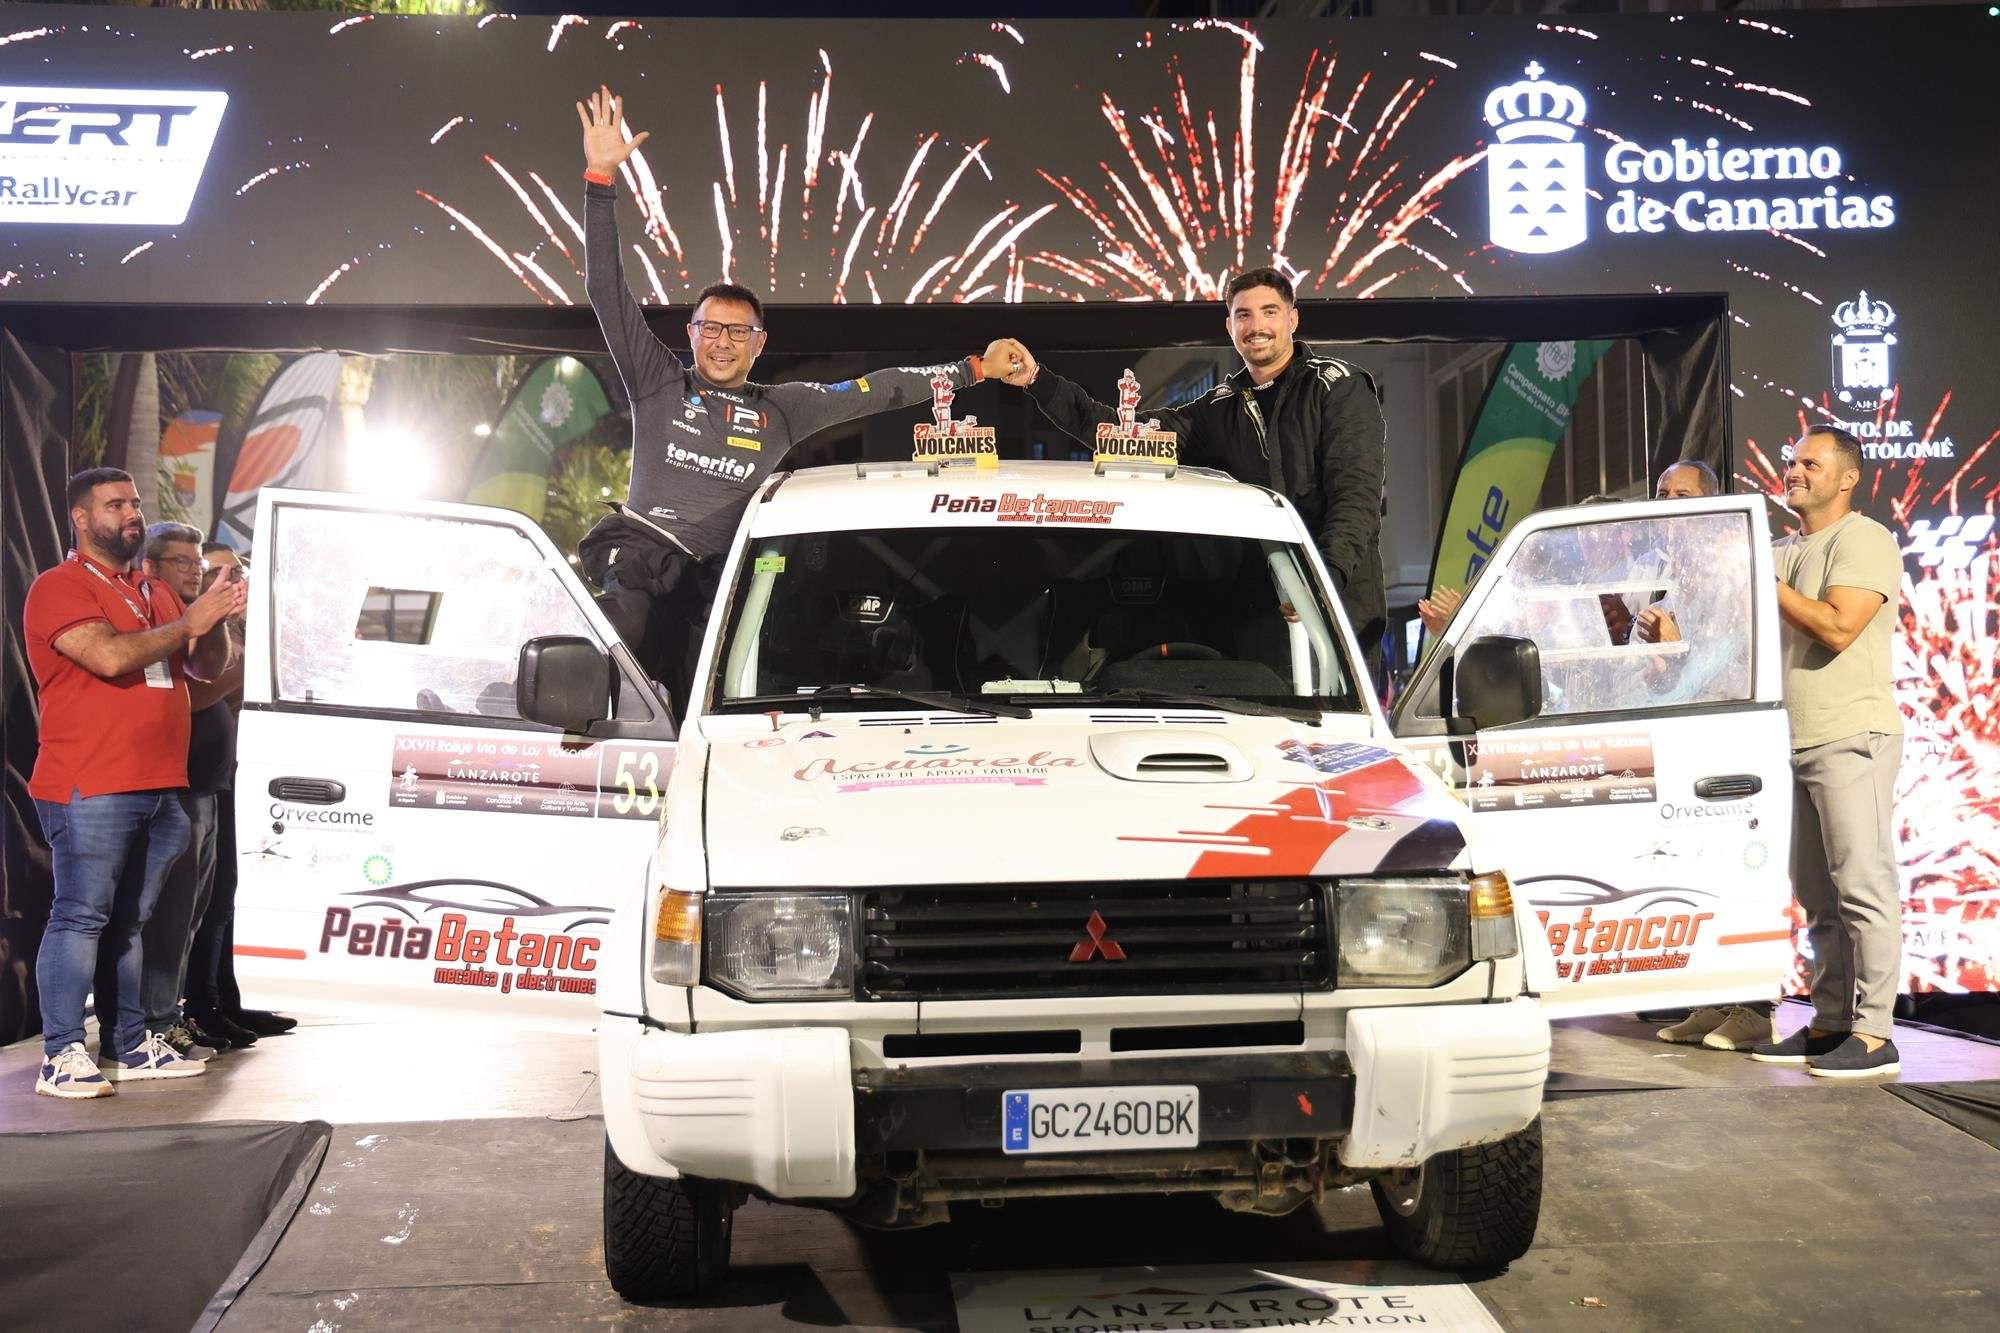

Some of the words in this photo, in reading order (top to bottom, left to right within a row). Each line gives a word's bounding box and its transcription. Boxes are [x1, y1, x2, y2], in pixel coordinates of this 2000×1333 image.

[1604, 138, 1842, 184] Gobierno
[0, 176, 138, 206] Rallycar
[1605, 190, 1666, 233] de
[1673, 187, 1896, 233] Canarias
[1507, 363, 1556, 409] Campeonato
[672, 419, 702, 436] worten
[1885, 420, 1914, 437] DE
[916, 437, 995, 456] VOLCANES
[1098, 438, 1175, 458] VOLCANES
[930, 493, 997, 513] Peña
[998, 493, 1125, 515] Betancor
[851, 598, 881, 612] OMP
[501, 742, 518, 754] de
[447, 767, 540, 784] LANZAROTE
[794, 751, 1085, 781] Acuarela
[1520, 763, 1606, 780] LANZAROTE
[613, 751, 660, 816] 53
[269, 803, 374, 826] Orvecame
[1660, 801, 1755, 820] Orvecame
[319, 906, 433, 960] Peña
[434, 913, 601, 971] Betanc
[501, 971, 513, 994] y
[1572, 961, 1586, 983] y
[1031, 1099, 1194, 1139] GC2460BK
[1012, 1128, 1023, 1141] E
[1024, 1295, 1414, 1321] LANZAROTE
[1029, 1322, 1168, 1333] SPORTS
[1183, 1314, 1427, 1331] DESTINATION
